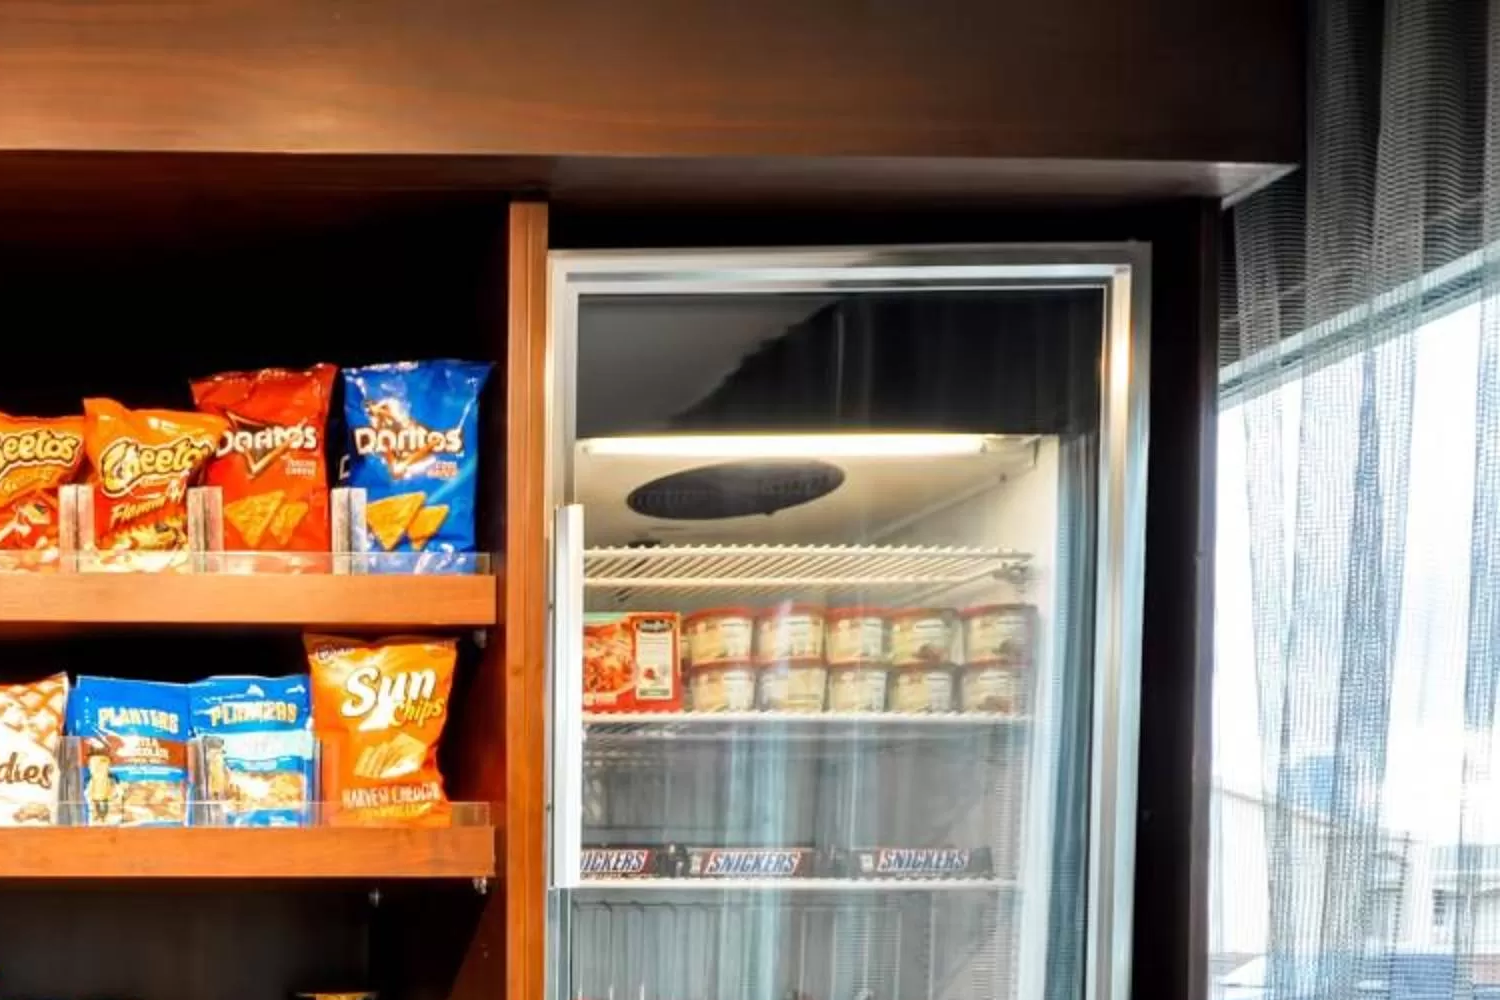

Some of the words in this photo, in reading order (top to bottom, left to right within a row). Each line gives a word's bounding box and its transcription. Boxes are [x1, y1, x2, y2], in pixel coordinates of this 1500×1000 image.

[355, 426, 463, 455] Doritos
[101, 438, 211, 494] Cheeto
[341, 667, 437, 732] Sun
[97, 706, 180, 734] PLANTERS
[706, 850, 799, 874] SNICKERS
[877, 849, 971, 872] SNICKERS
